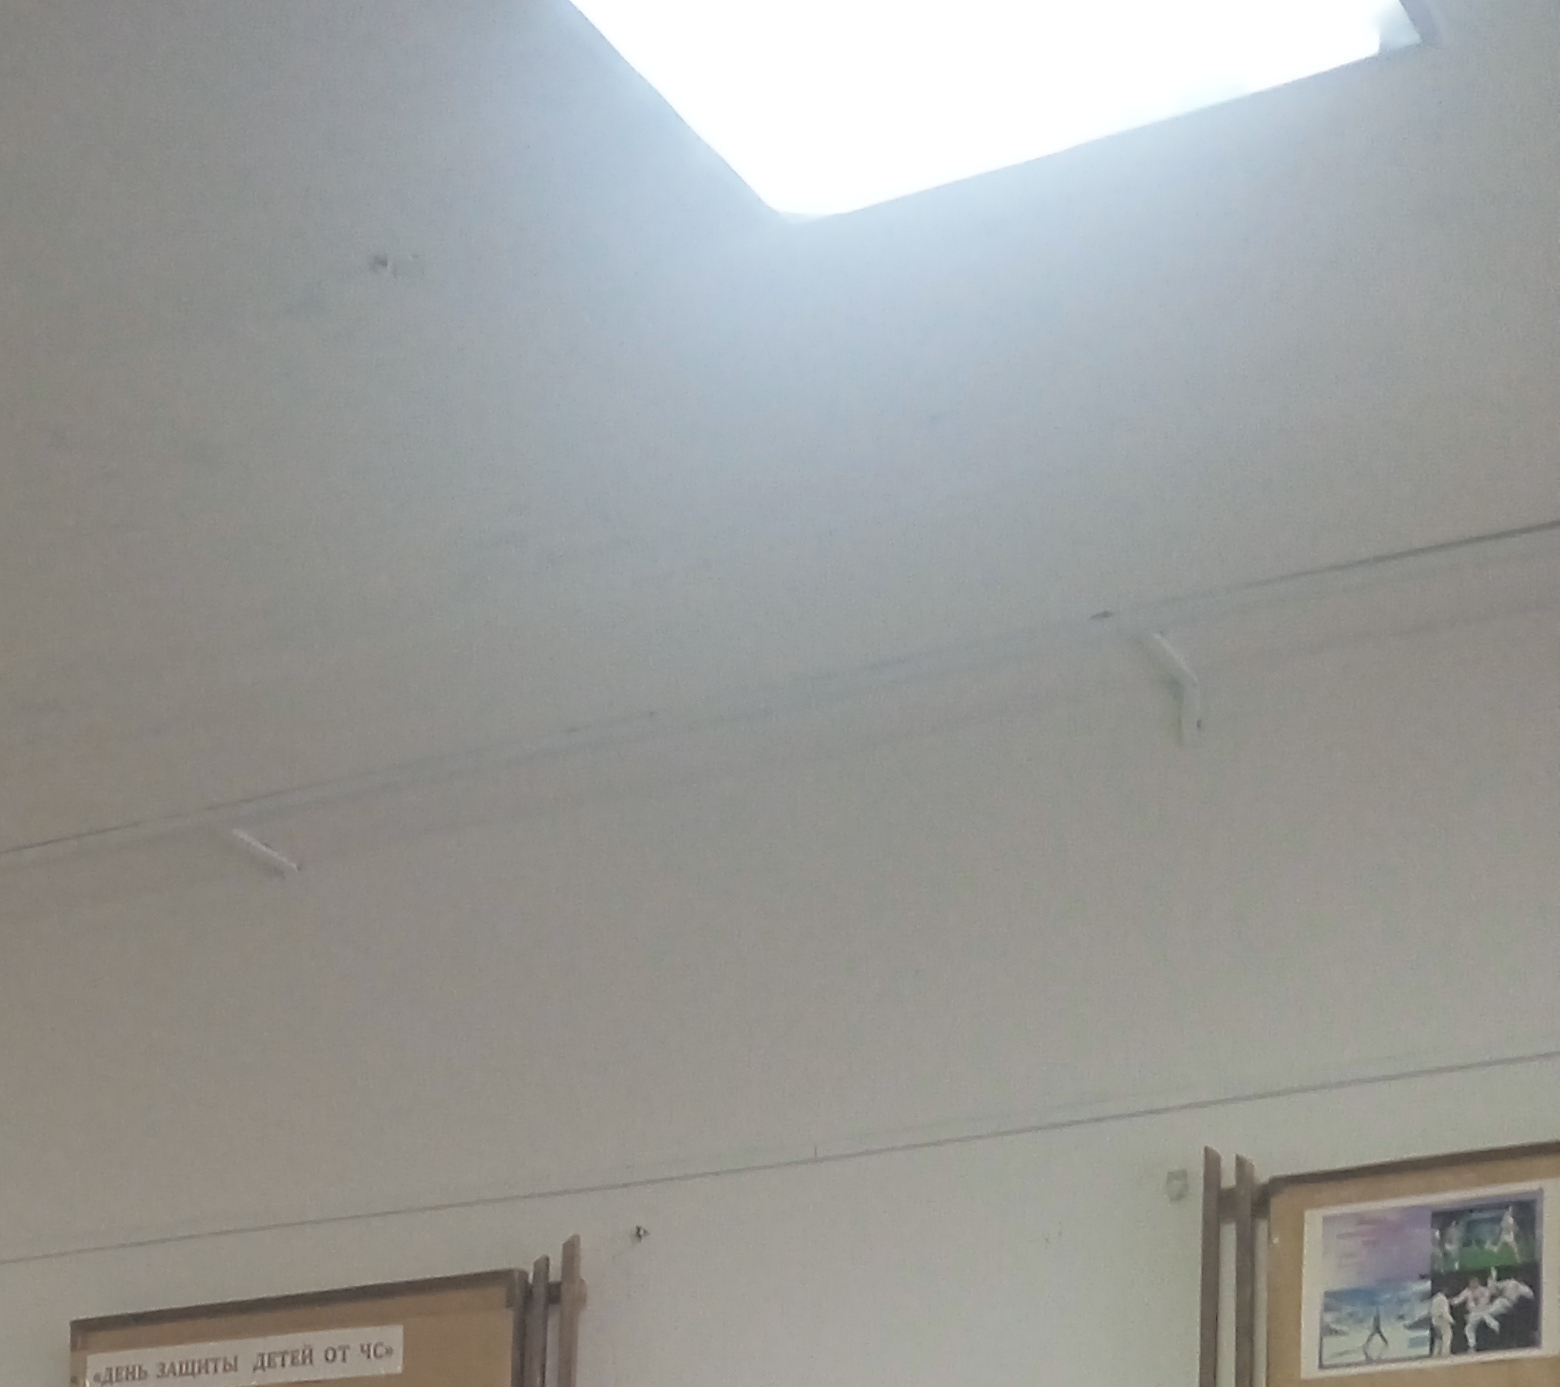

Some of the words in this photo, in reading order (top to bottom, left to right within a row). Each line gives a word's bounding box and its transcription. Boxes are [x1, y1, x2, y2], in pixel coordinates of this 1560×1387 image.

[92, 1362, 148, 1387] «ДЕНЬ
[155, 1354, 239, 1381] ЗАЩИТЫ
[252, 1344, 314, 1374] ДЕТЕЙ
[324, 1343, 351, 1365] ОТ
[360, 1340, 395, 1363] ЧС»
